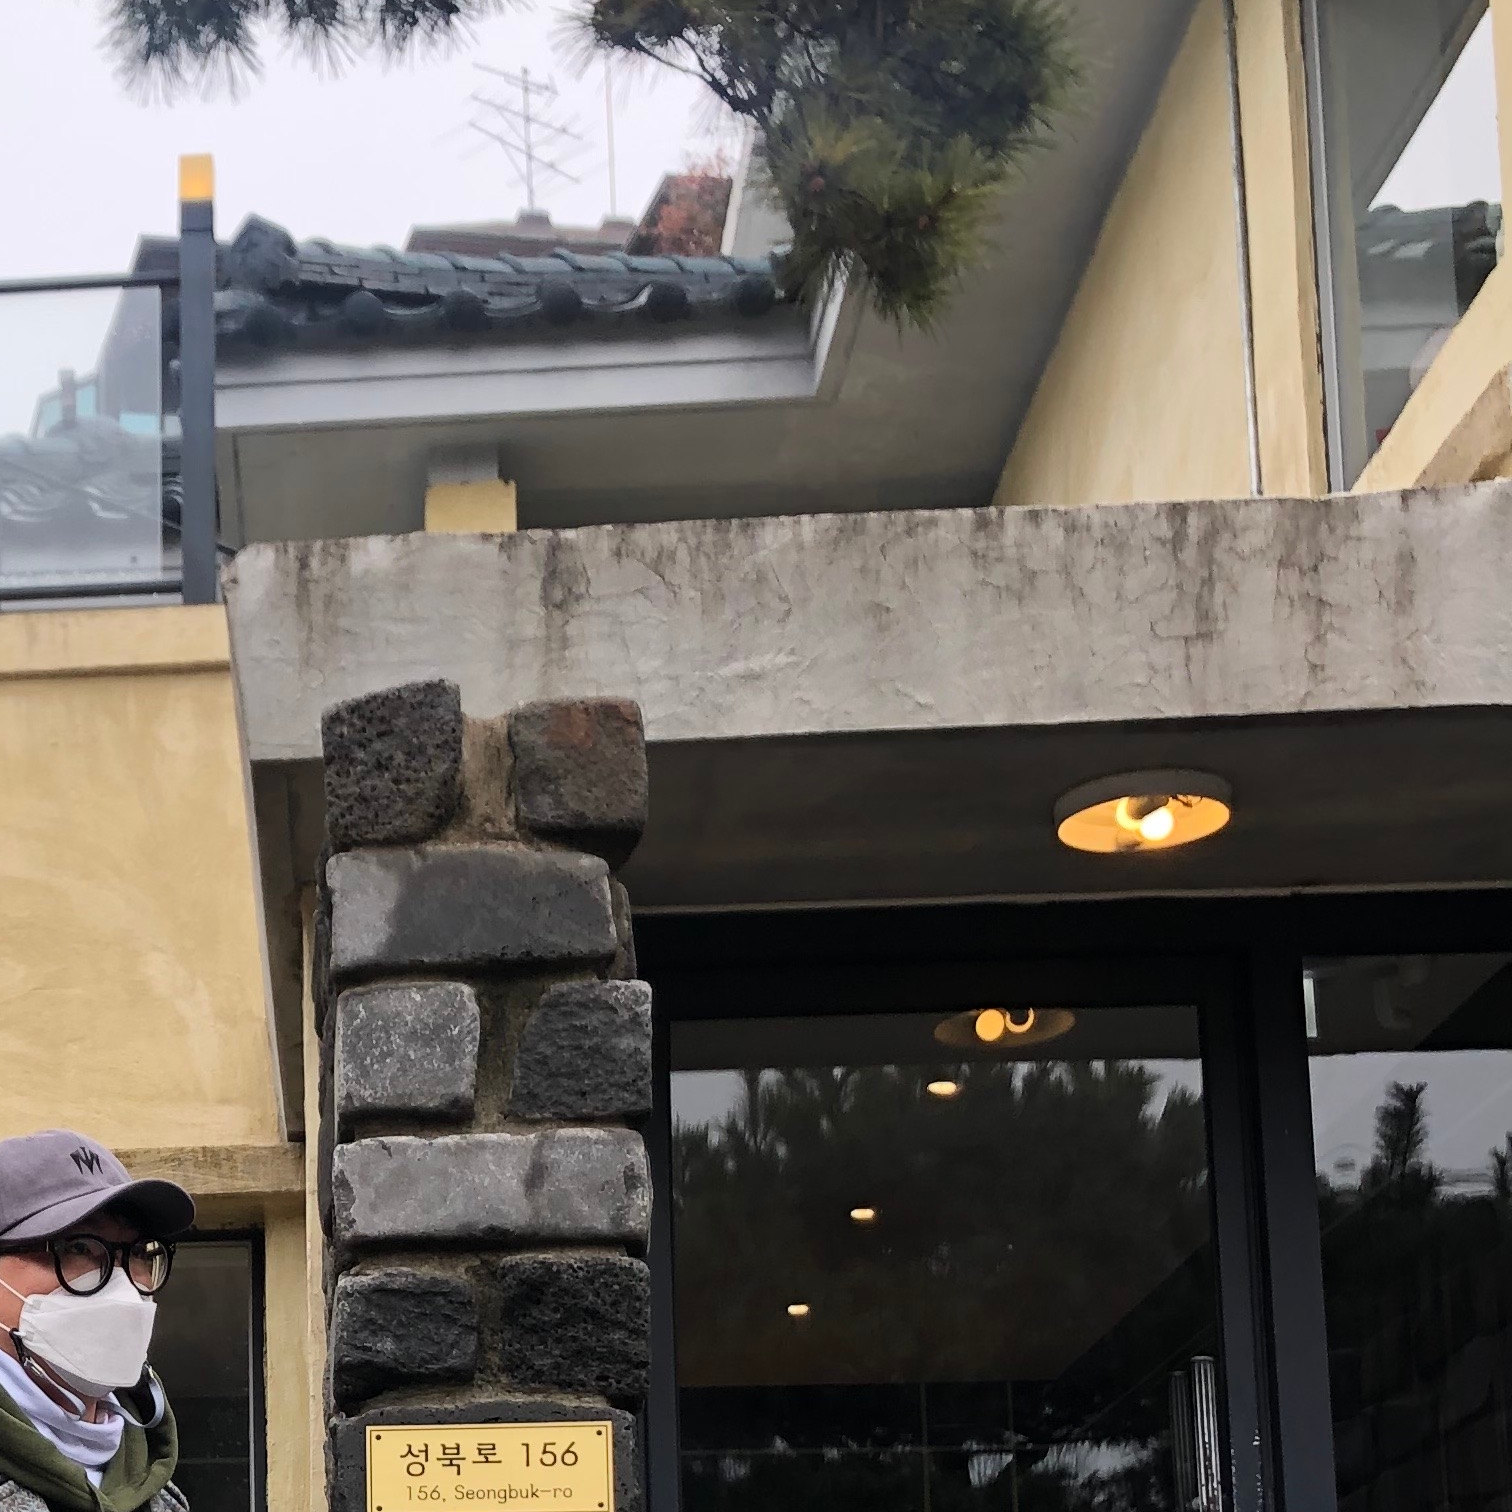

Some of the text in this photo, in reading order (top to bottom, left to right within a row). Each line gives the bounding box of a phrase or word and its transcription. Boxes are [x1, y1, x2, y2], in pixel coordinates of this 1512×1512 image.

[399, 1441, 579, 1477] 성북로 156
[406, 1483, 573, 1504] 156, Seongbuk-ro
